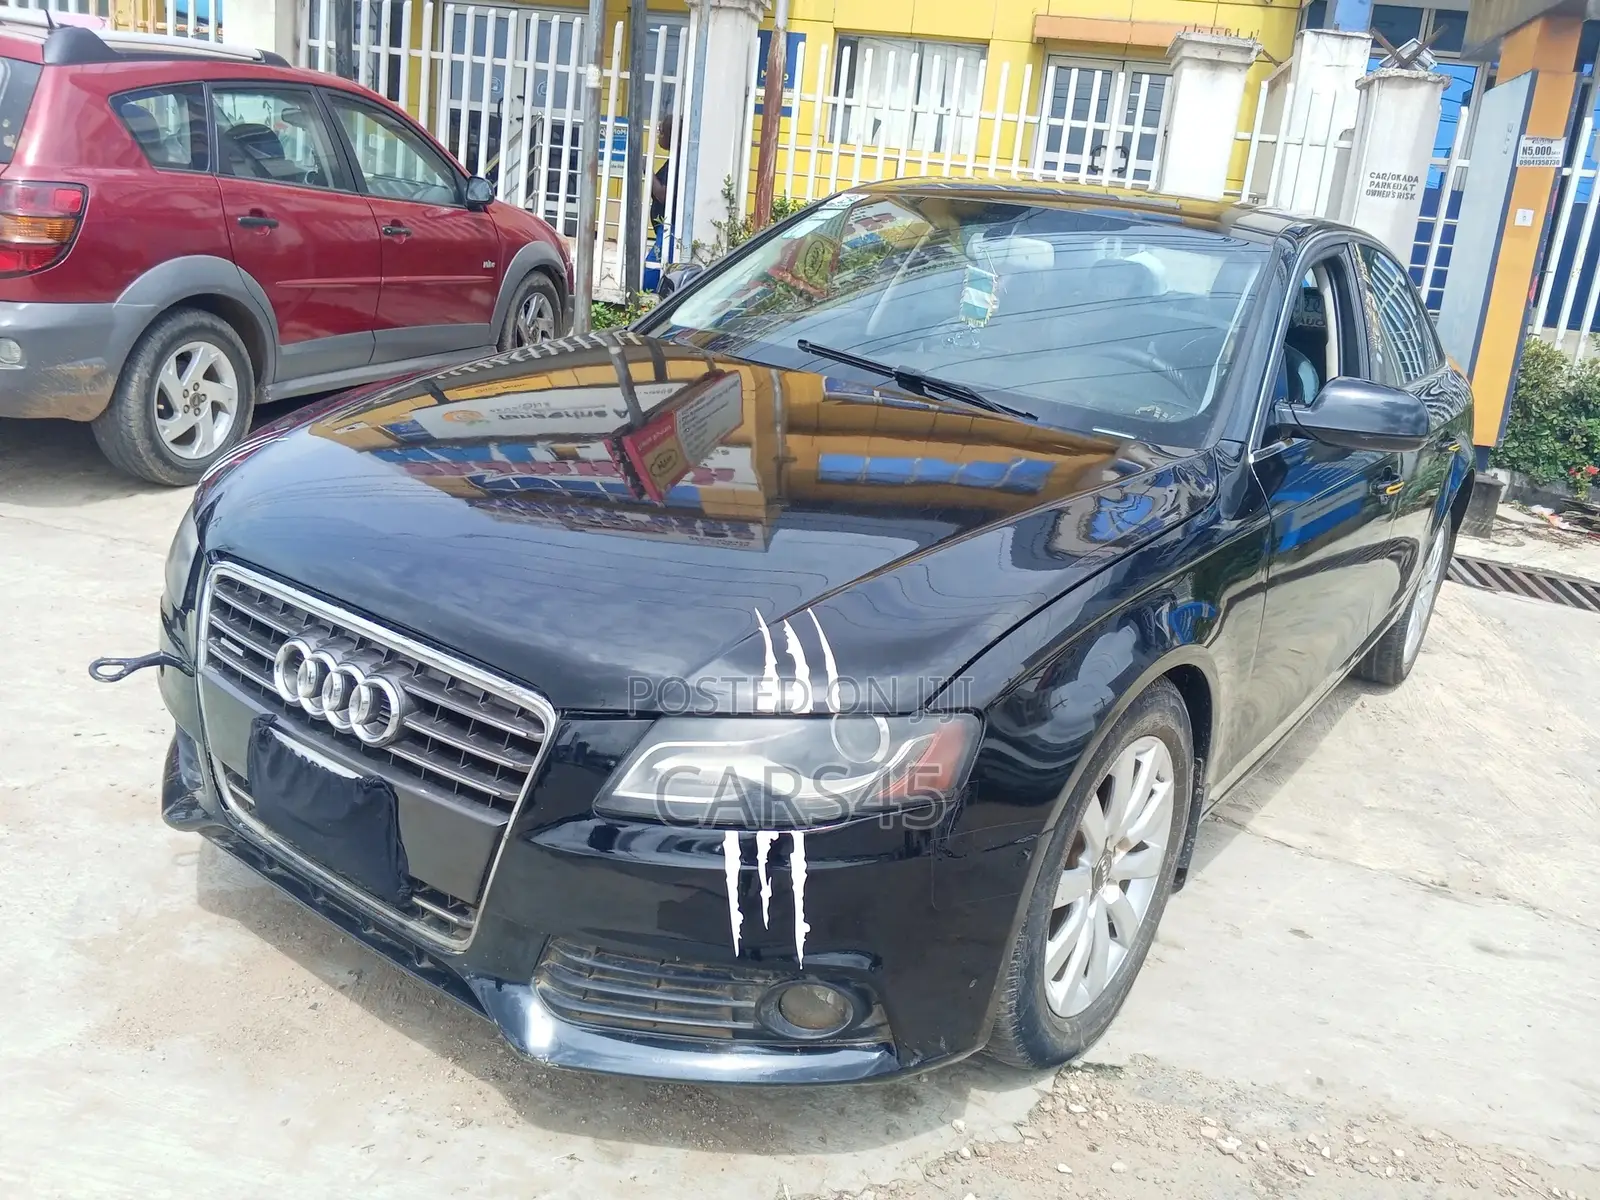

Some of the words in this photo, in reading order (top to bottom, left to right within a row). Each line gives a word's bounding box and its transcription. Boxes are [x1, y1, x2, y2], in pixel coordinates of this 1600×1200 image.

[1369, 172, 1419, 183] CAR/OKADA
[1369, 180, 1403, 191] PARKED
[1402, 183, 1417, 191] AT
[1365, 188, 1397, 199] OWNER'S
[1396, 191, 1416, 201] RISK
